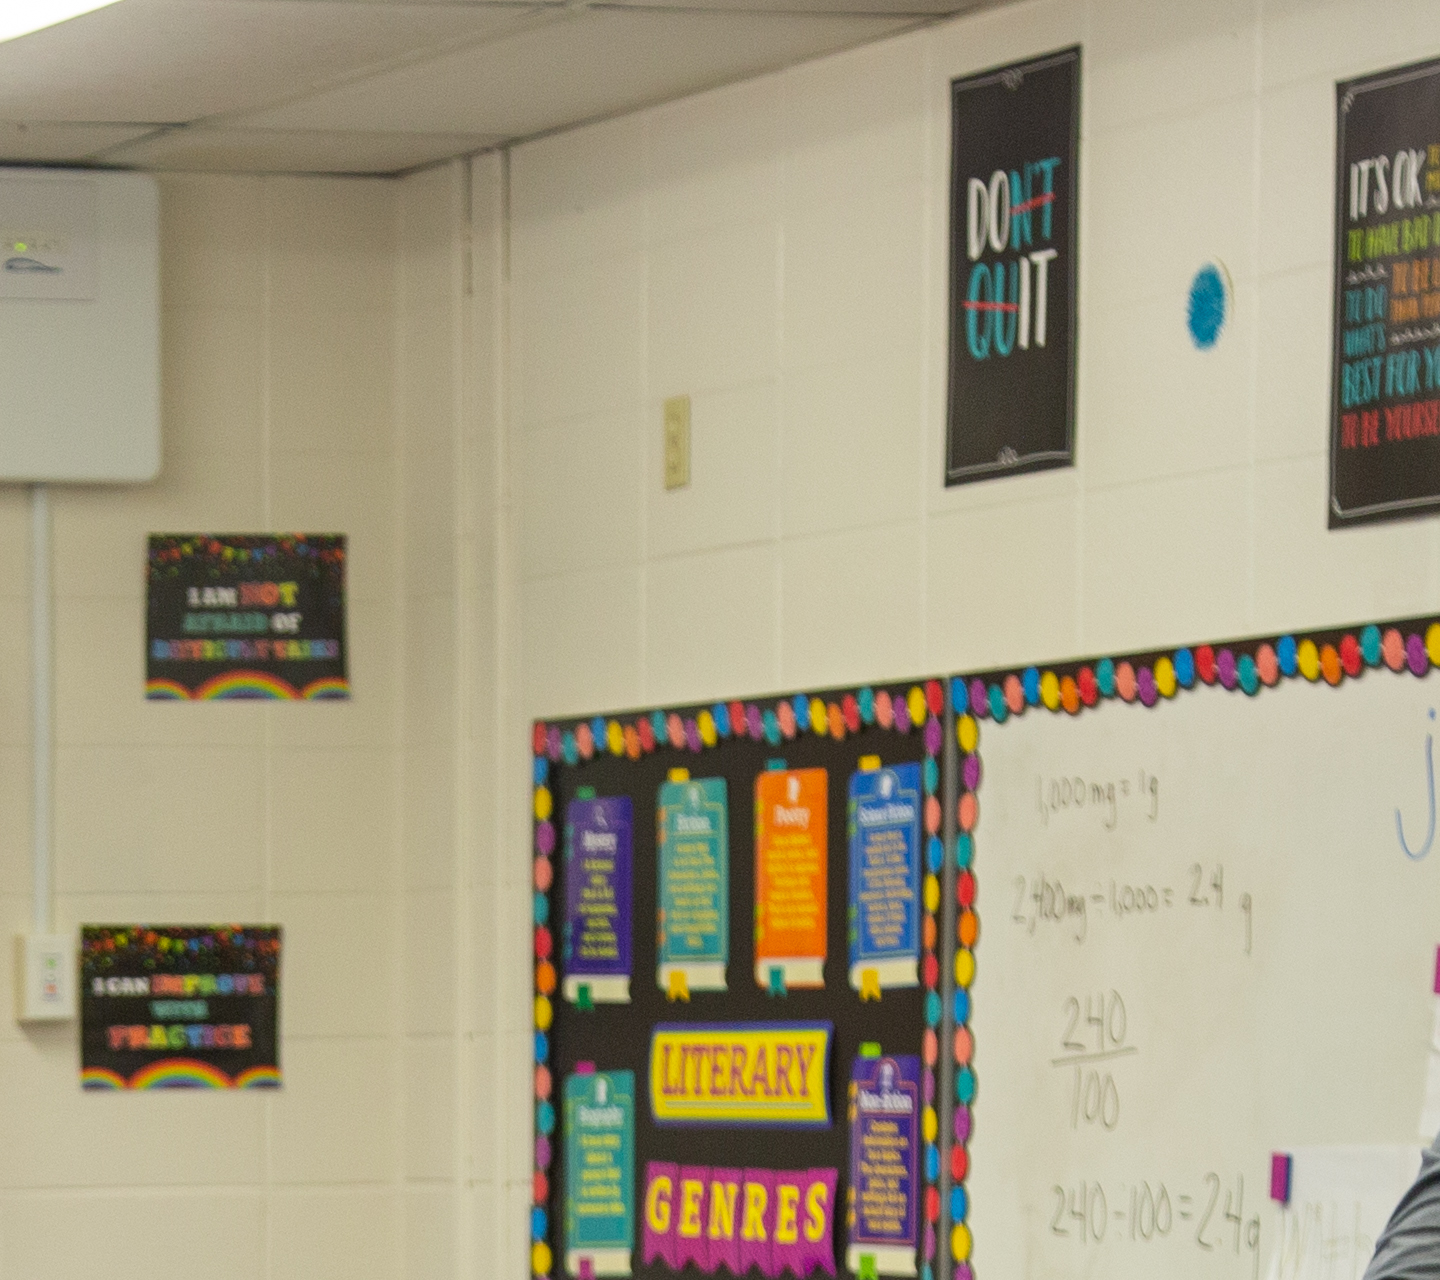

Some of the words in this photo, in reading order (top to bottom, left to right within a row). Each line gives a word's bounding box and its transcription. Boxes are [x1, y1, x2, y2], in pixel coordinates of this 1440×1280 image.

[1349, 154, 1390, 221] IT'S
[1392, 148, 1426, 210] OK
[1365, 221, 1400, 259] HAVE
[1401, 214, 1430, 254] BAD
[964, 249, 1058, 360] QUIT
[1341, 357, 1382, 409] BEST
[1385, 350, 1420, 397] FOR
[187, 587, 200, 607] I
[202, 587, 238, 607] AM
[239, 582, 299, 606] NOT
[272, 613, 302, 633] OF
[93, 976, 105, 996] I
[106, 977, 149, 996] CAN
[108, 1024, 251, 1049] PRACTICE
[1060, 988, 1128, 1052] 240
[663, 1044, 816, 1096] LITERARY
[1070, 1064, 1121, 1132] 100
[645, 1175, 828, 1245] GENRES
